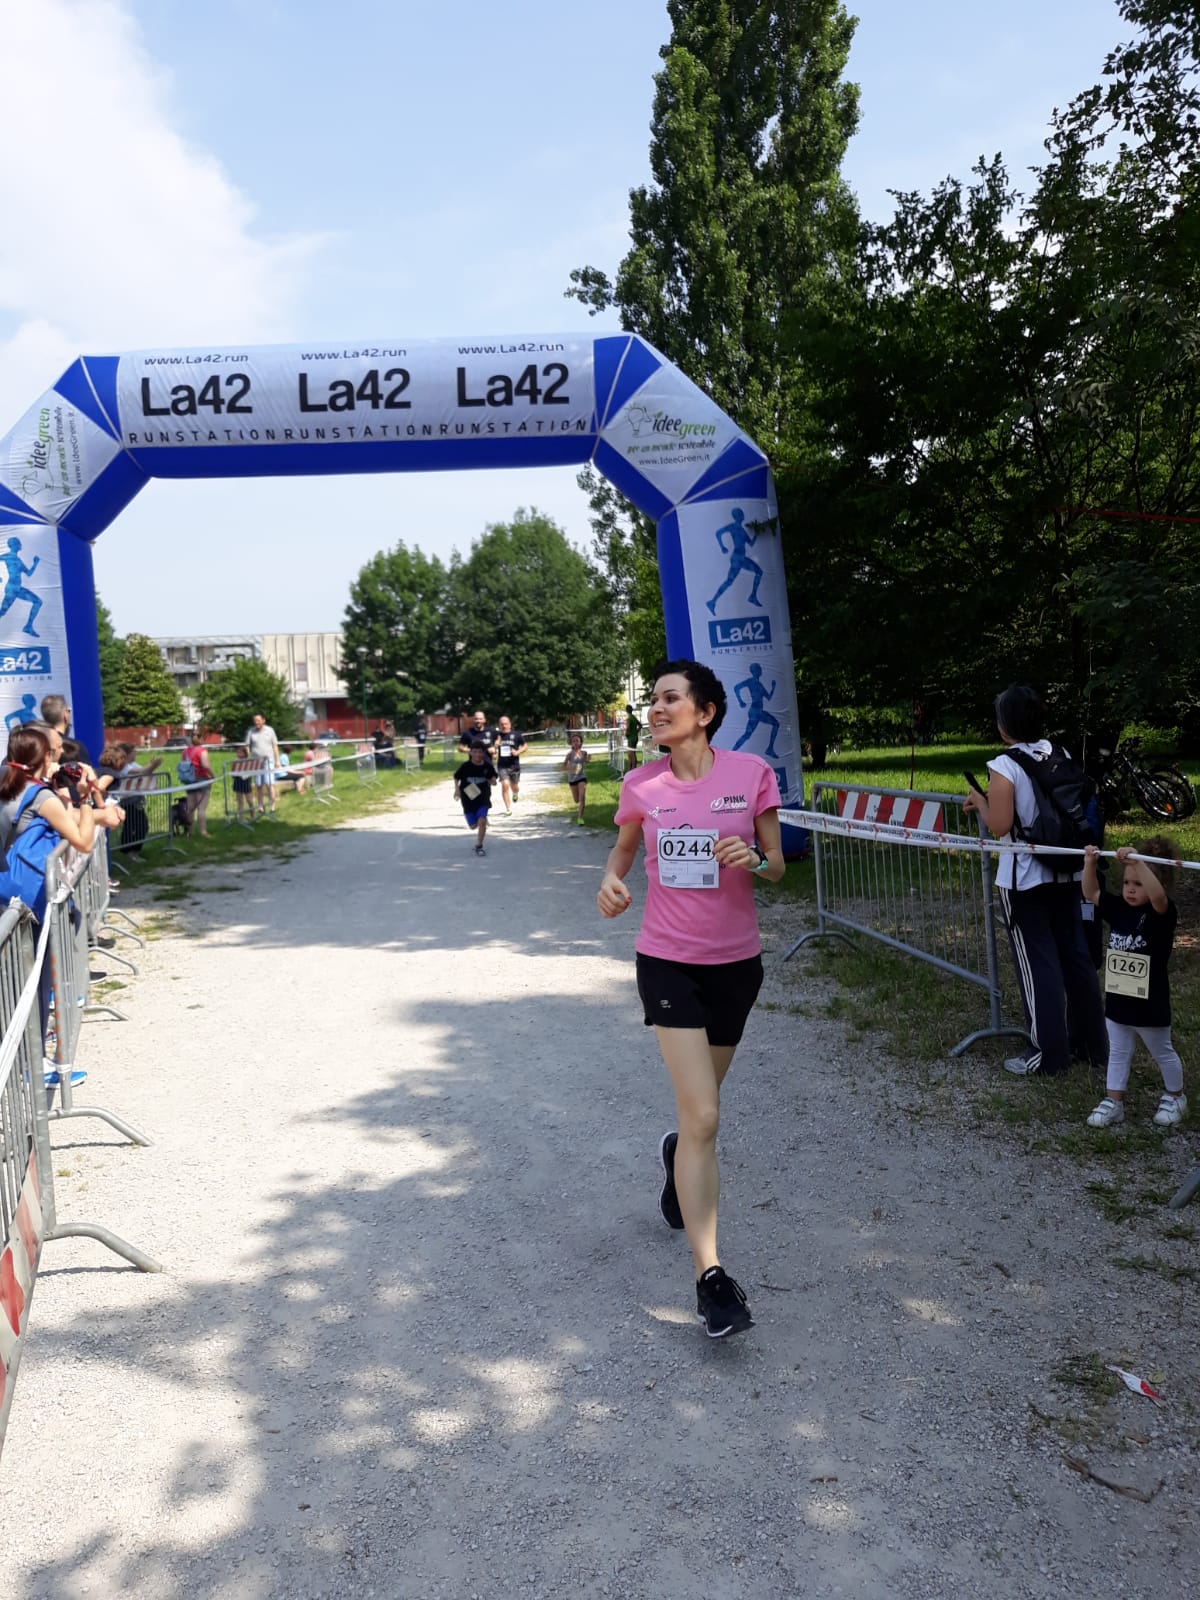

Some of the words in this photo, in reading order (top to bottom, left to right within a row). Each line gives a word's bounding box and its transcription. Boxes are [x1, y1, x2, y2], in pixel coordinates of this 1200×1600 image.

[301, 347, 407, 361] www.La42.run
[458, 342, 565, 355] www.La42.run
[144, 353, 249, 366] www.La42.run
[298, 367, 412, 413] La42
[456, 362, 570, 408] La42
[141, 372, 253, 417] La42
[715, 620, 766, 644] La42
[723, 794, 746, 804] PINK
[663, 839, 712, 857] 0244
[1112, 958, 1145, 975] 1267
